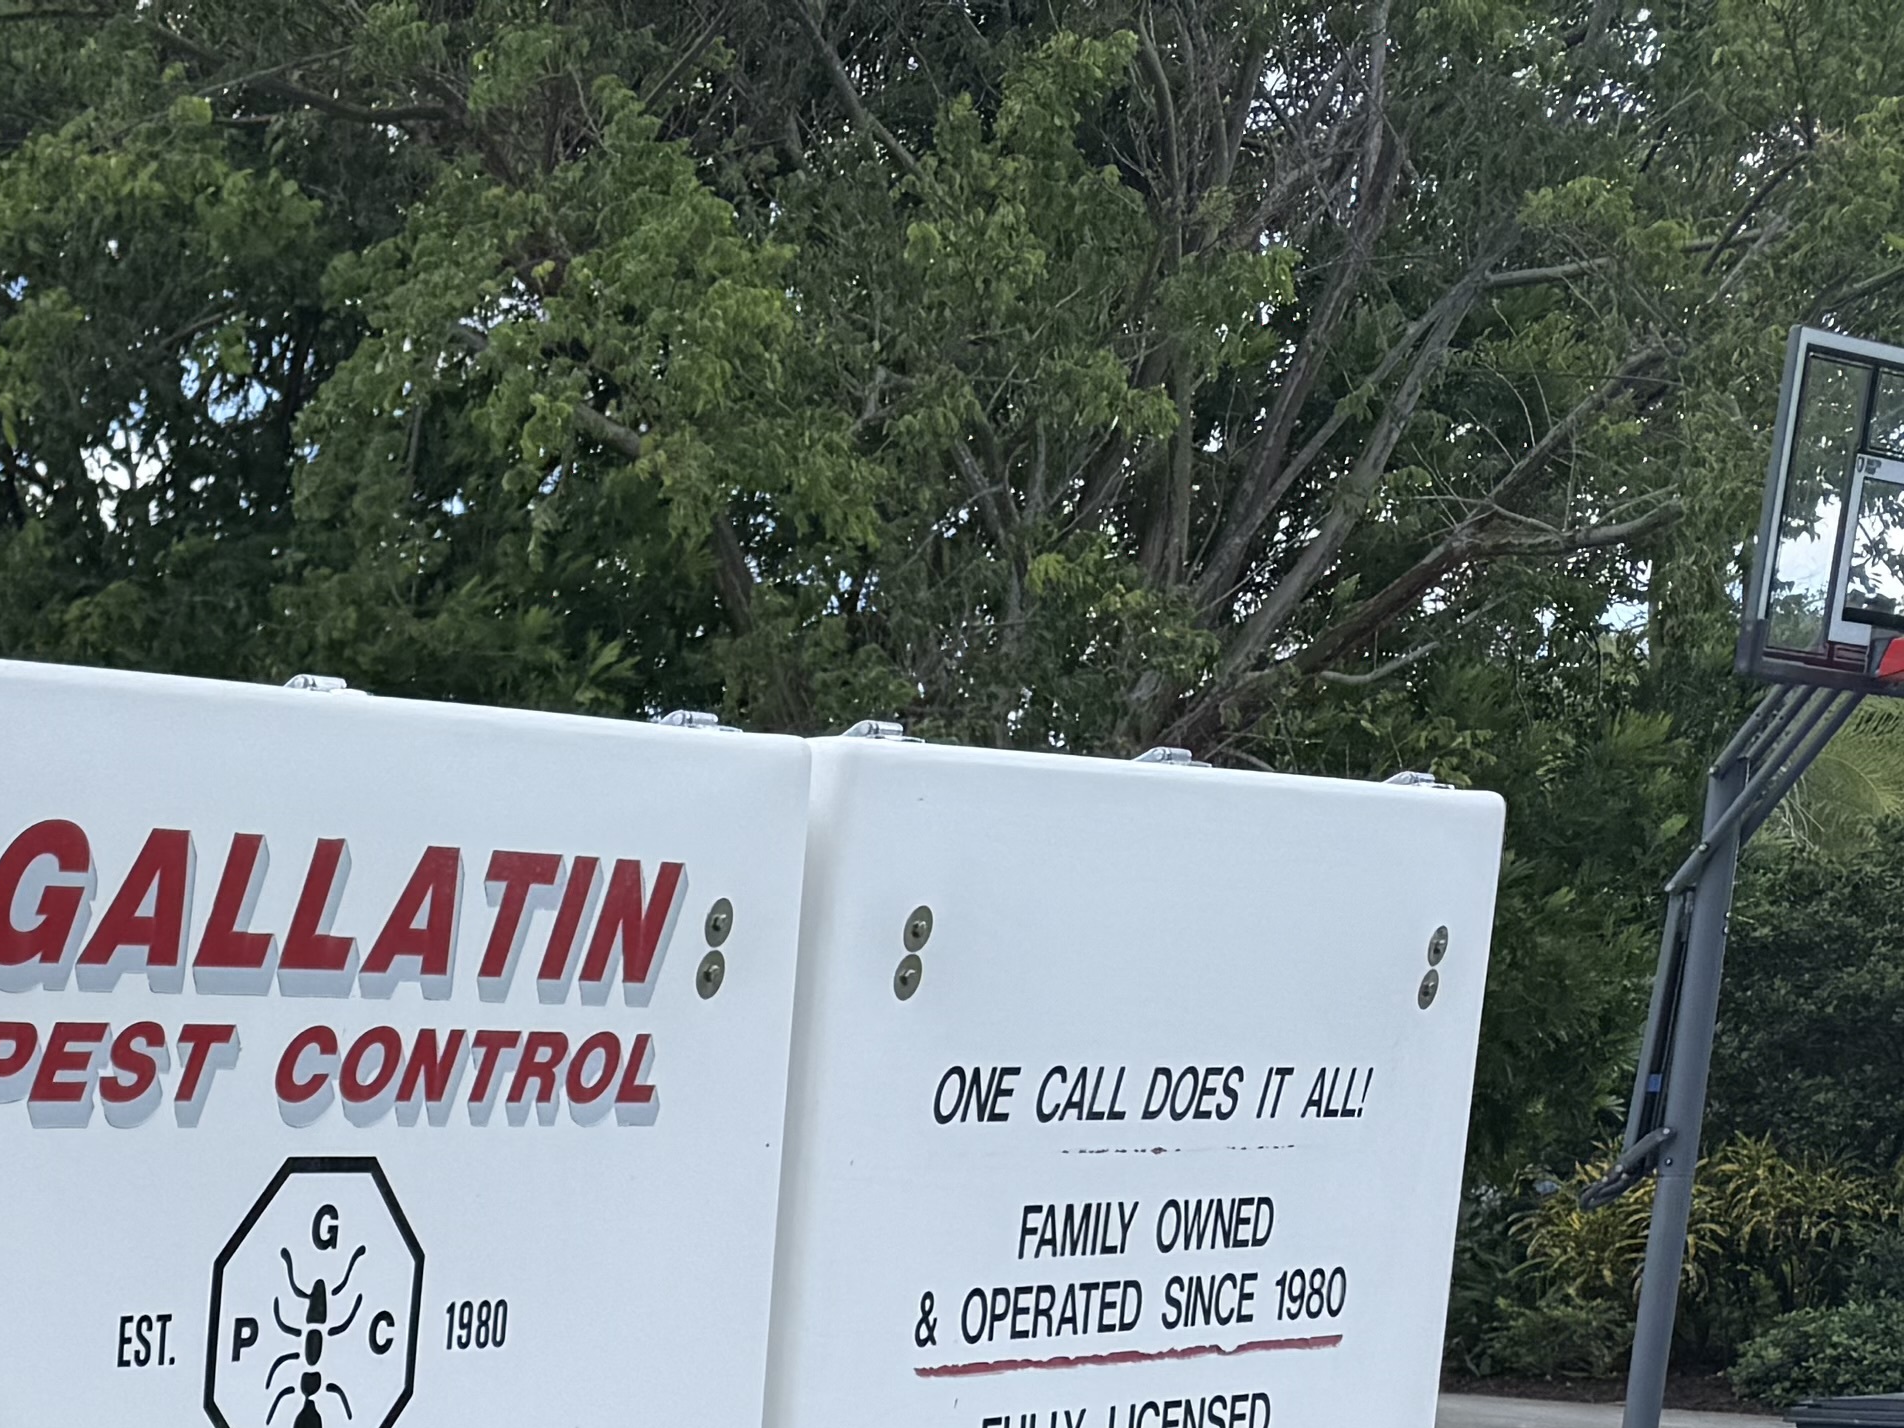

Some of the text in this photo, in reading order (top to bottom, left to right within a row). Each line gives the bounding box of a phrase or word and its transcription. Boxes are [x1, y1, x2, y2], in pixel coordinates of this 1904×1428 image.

[275, 1024, 660, 1128] CONTROL
[934, 1065, 1374, 1125] ONE CALL DOES IT ALL!
[311, 1204, 340, 1252] G
[1017, 1195, 1274, 1260] FAMILY OWNED
[117, 1298, 508, 1368] EST. P C 1980
[914, 1266, 1347, 1348] & OPERATED SINCE 1980
